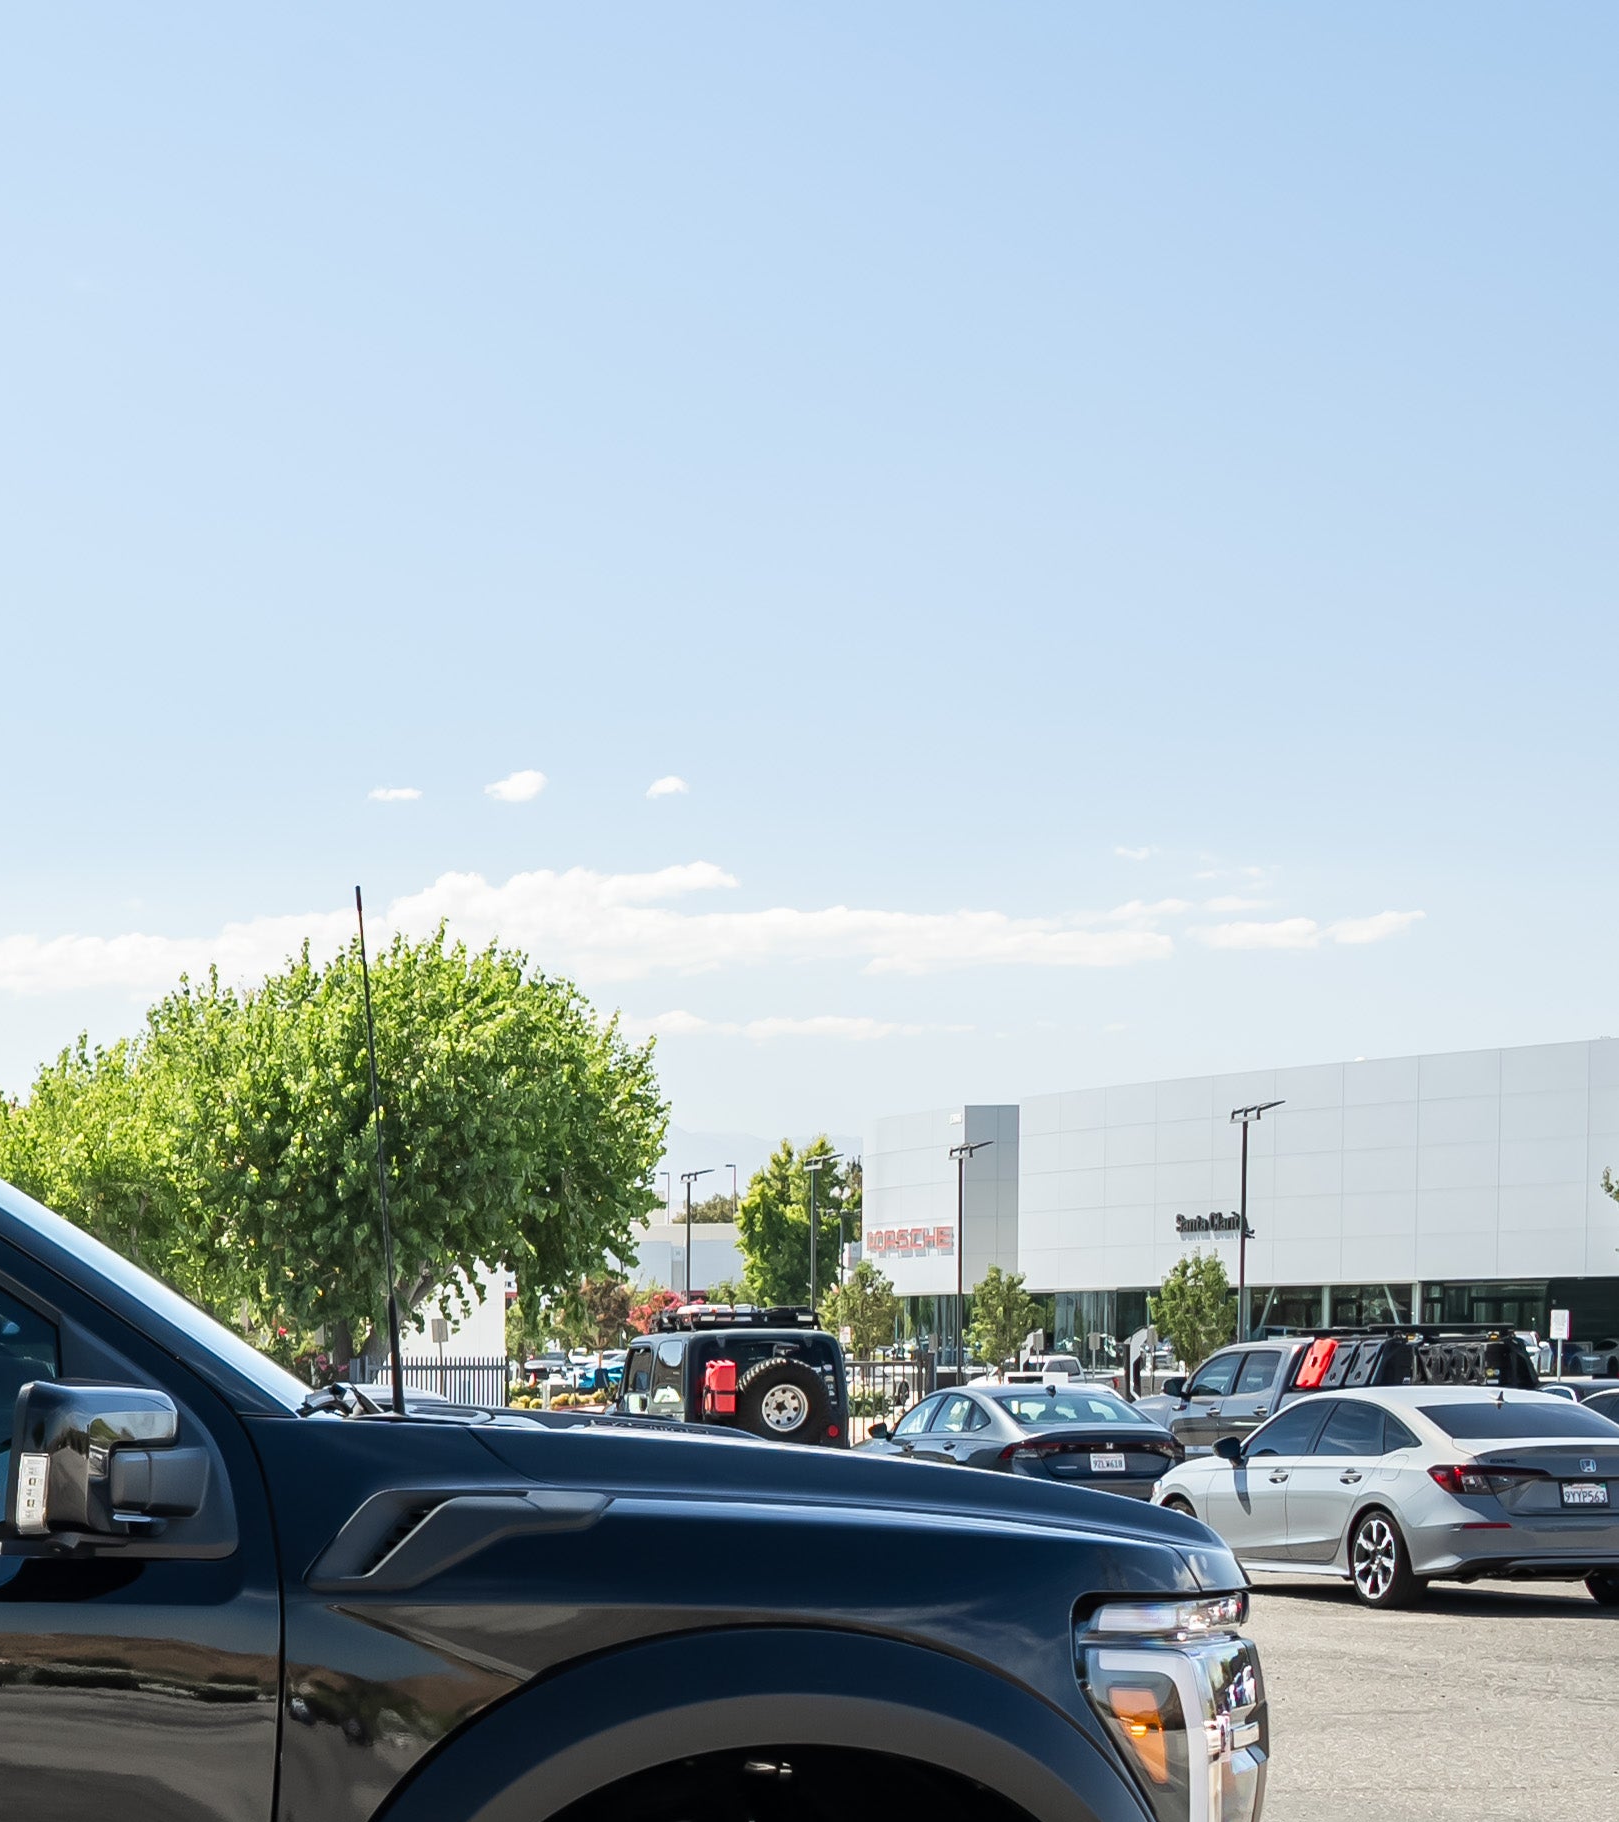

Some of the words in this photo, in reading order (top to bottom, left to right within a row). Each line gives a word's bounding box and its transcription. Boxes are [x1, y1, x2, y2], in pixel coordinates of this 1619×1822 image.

[1176, 1213, 1209, 1232] Santa
[866, 1226, 953, 1251] PORSCHE
[1565, 1490, 1606, 1503] 9YYP563
